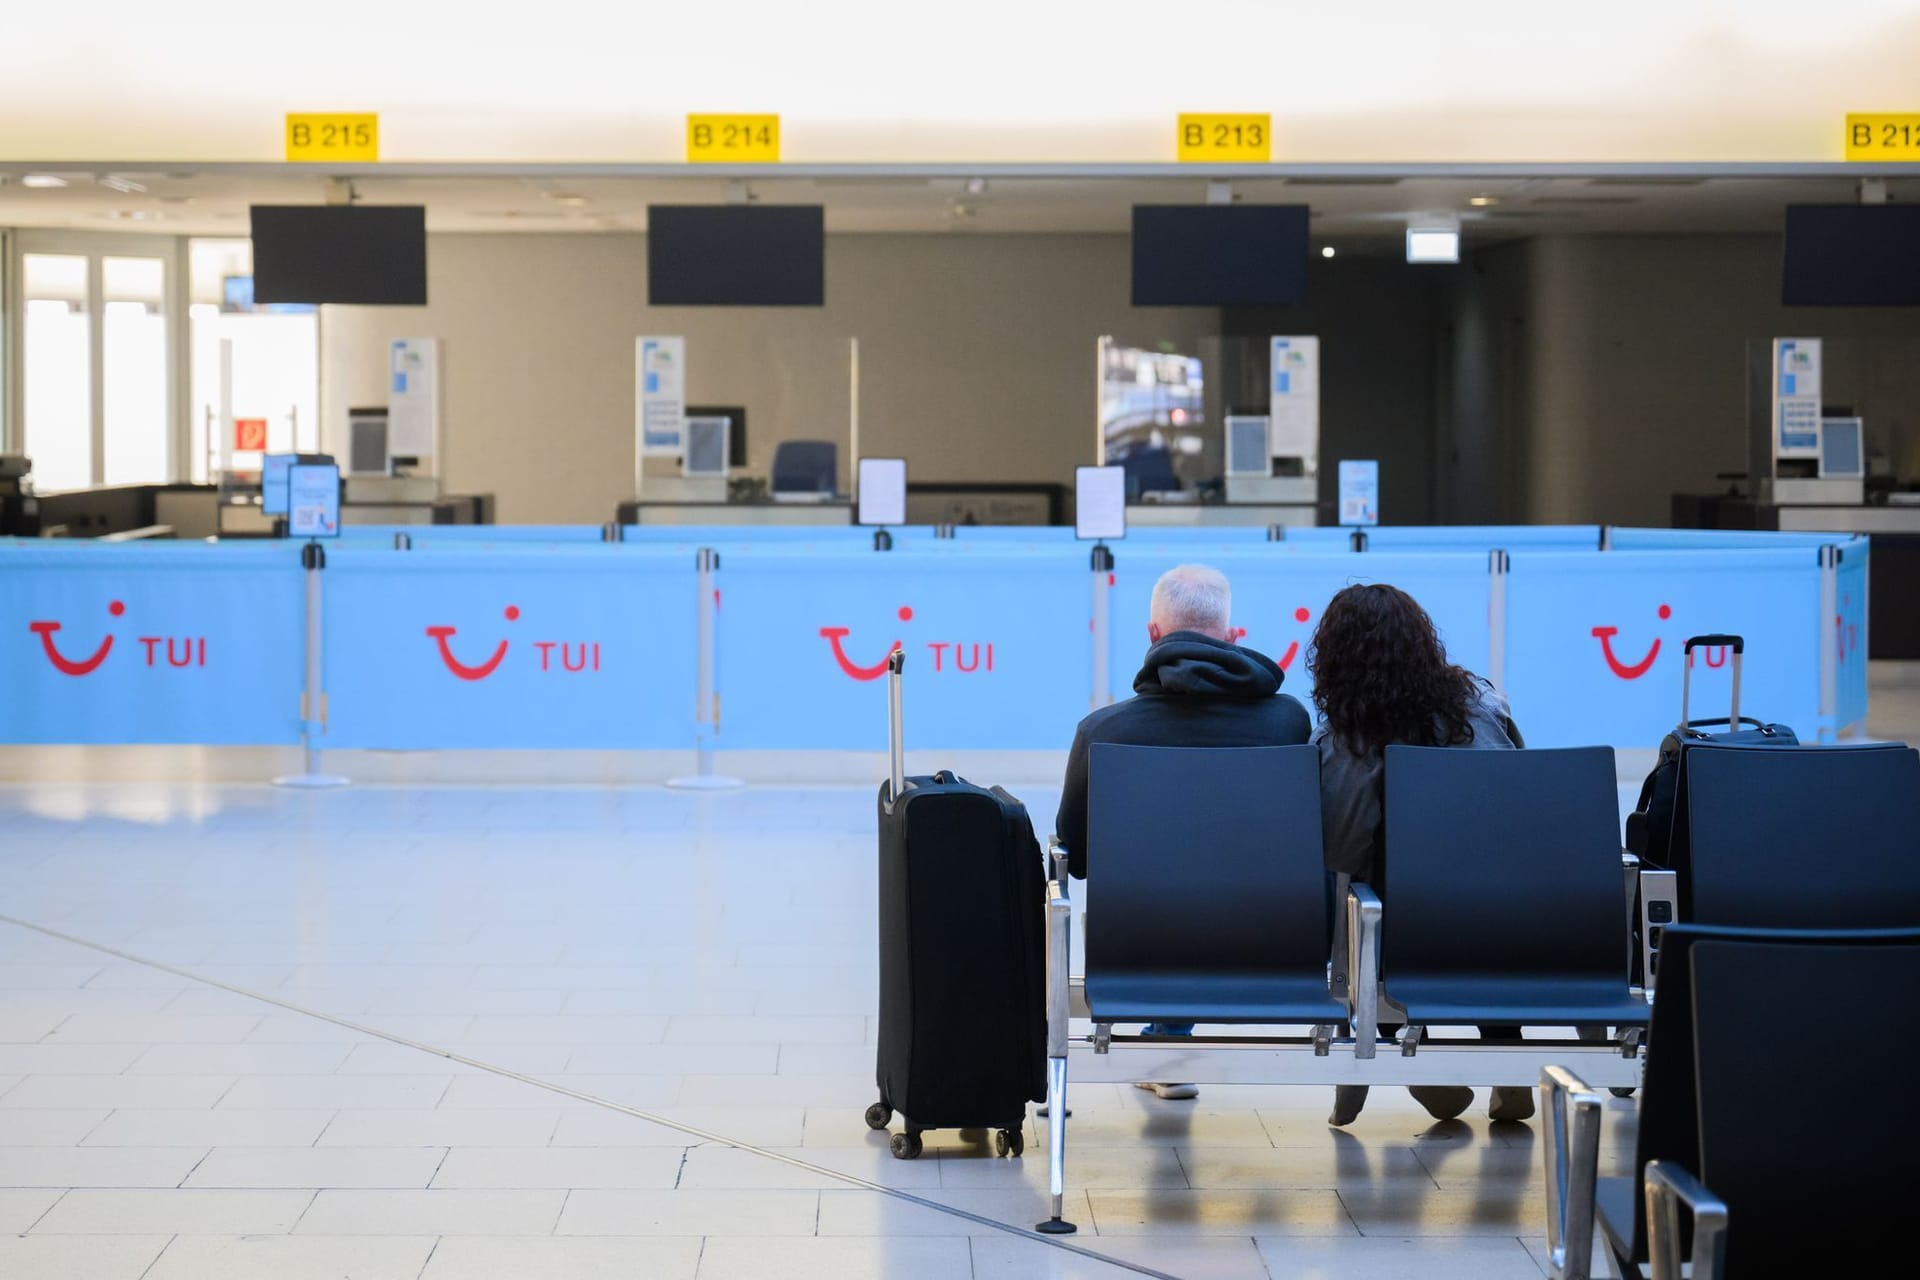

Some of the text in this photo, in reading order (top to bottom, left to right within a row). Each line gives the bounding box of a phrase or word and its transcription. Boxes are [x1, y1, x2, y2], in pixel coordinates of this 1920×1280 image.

[293, 123, 369, 147] B 215
[693, 123, 770, 147] B 214
[1185, 123, 1262, 147] B 213
[1853, 123, 1871, 147] B
[138, 637, 206, 668] TUI
[533, 641, 600, 673] TUI
[927, 642, 993, 673] TUI
